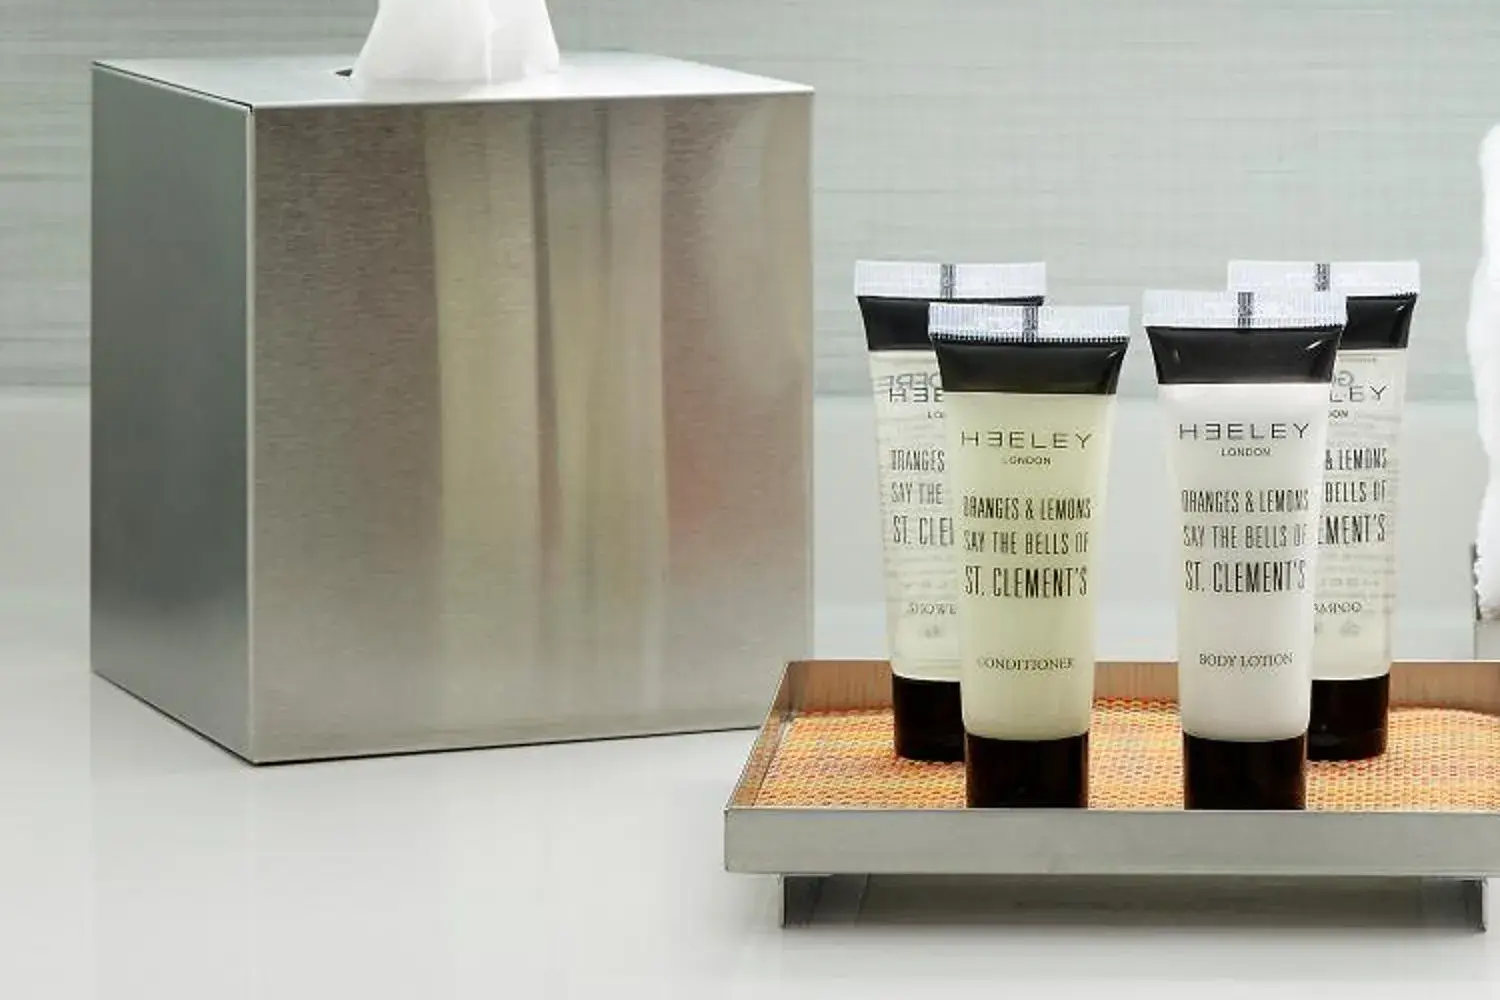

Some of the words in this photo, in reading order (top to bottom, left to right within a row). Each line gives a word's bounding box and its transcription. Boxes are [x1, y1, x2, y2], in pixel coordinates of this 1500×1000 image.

[1330, 386, 1387, 402] LEY
[1221, 448, 1271, 457] LONDON
[891, 481, 912, 504] SAY
[918, 482, 943, 505] THE
[1181, 489, 1240, 513] ORANGES
[1245, 489, 1255, 513] &
[1260, 489, 1309, 513] LEMONS
[963, 495, 1020, 520] ORANGES
[1025, 497, 1034, 520] &
[1041, 497, 1092, 520] LEMONS
[1183, 524, 1205, 548] SAY
[1212, 525, 1237, 549] THE
[1245, 525, 1287, 549] BELLS
[1317, 513, 1386, 545] EMENT'S
[964, 530, 985, 553] SAY
[993, 531, 1017, 555] THE
[1025, 531, 1069, 555] BELLS
[1075, 531, 1089, 553] OF
[965, 565, 985, 596] ST.
[993, 566, 1088, 599] CLEMENT'S
[1185, 560, 1205, 593] ST.
[1213, 560, 1306, 593] CLEMENT'S
[1199, 653, 1237, 668] BODY
[1240, 652, 1294, 669] LOTION
